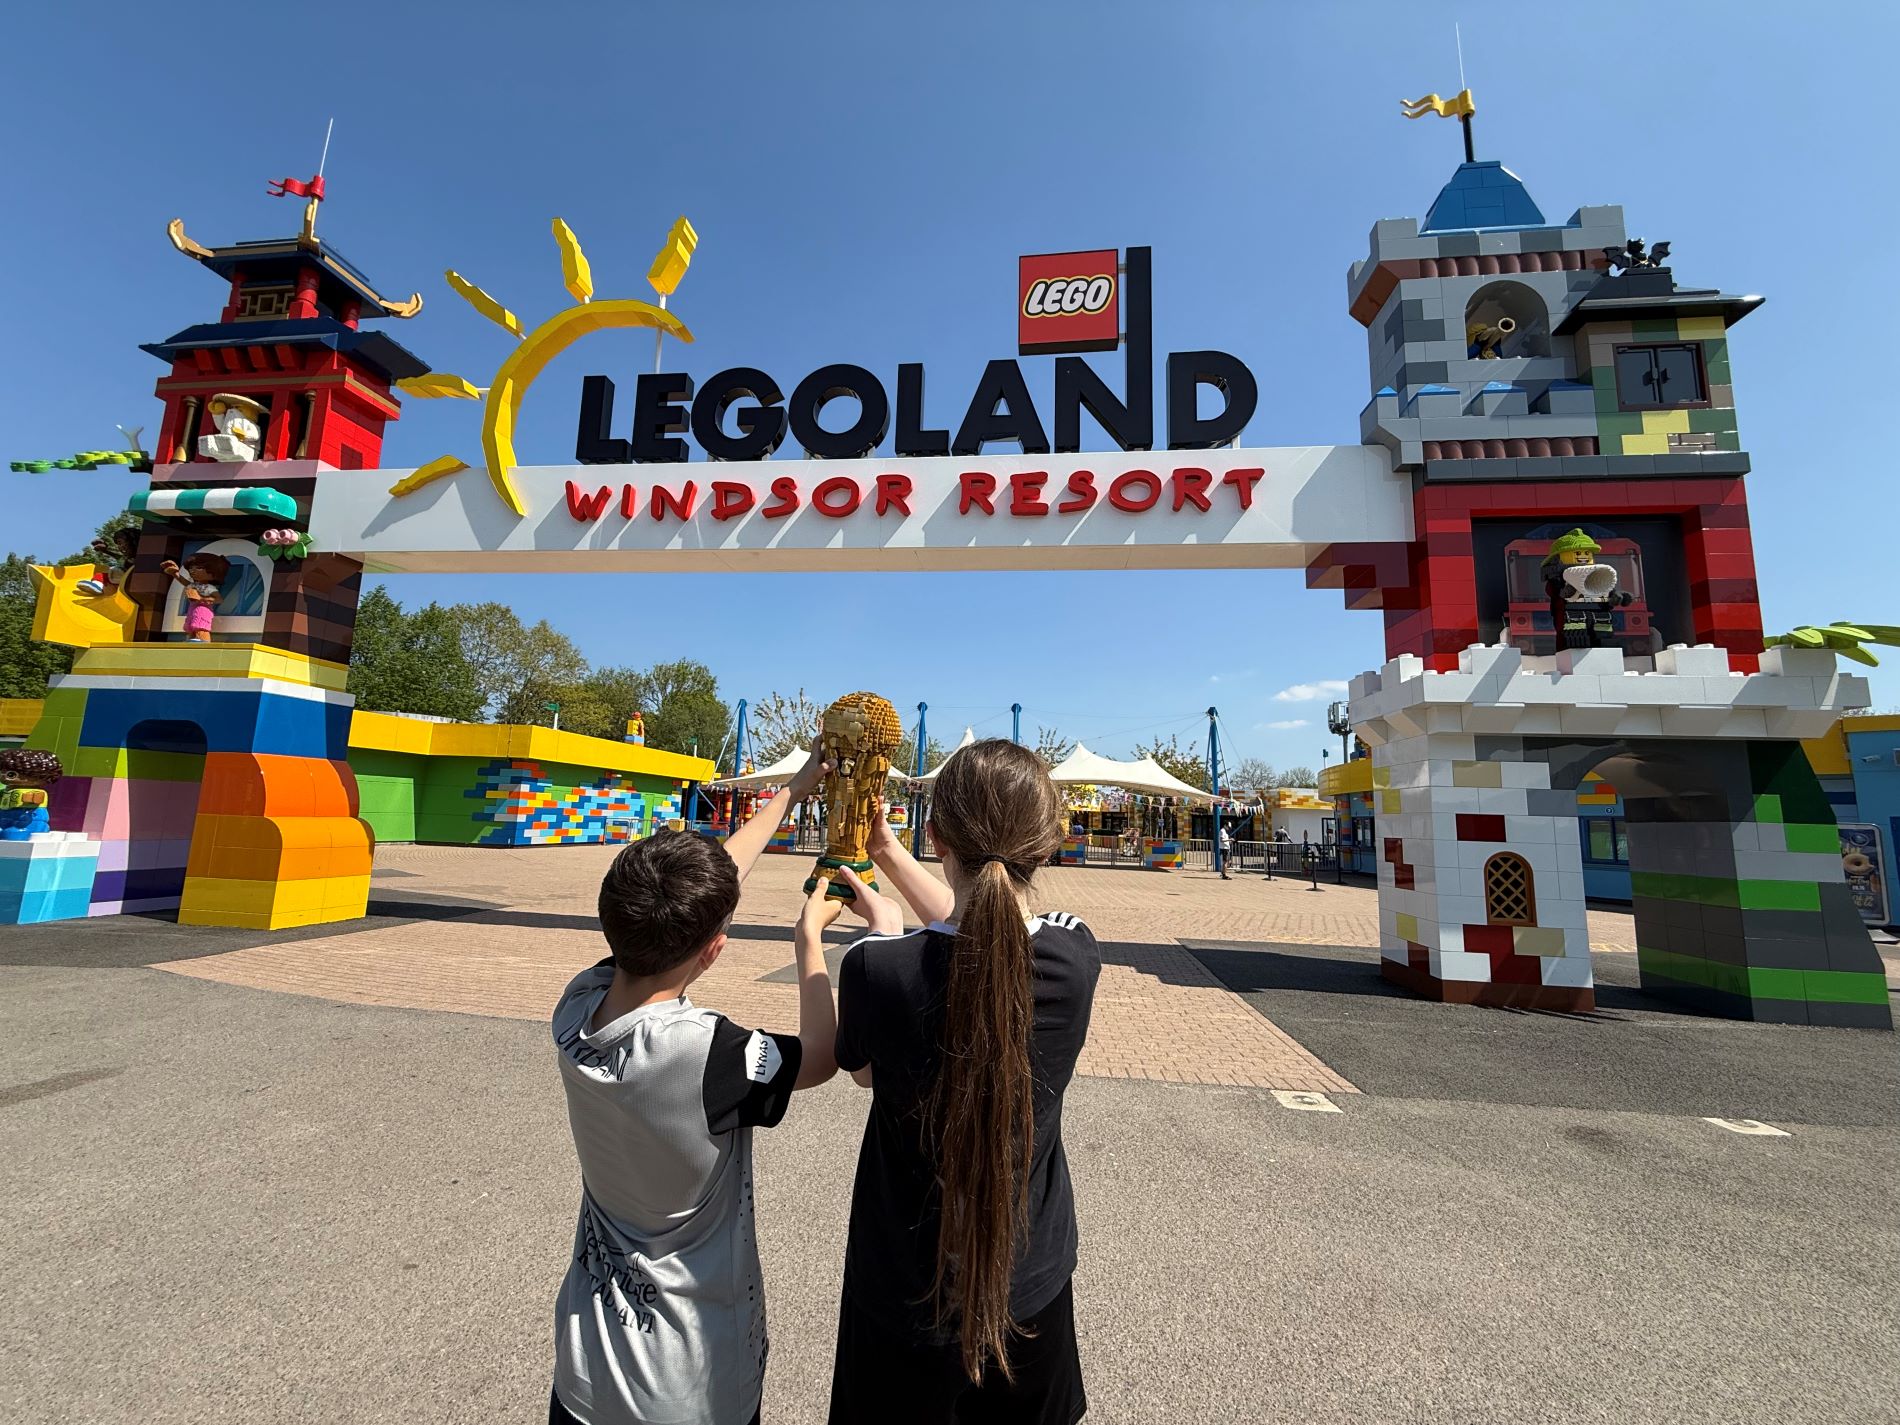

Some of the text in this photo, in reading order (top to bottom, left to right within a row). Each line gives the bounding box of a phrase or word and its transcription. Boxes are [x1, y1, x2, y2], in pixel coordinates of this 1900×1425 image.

[1026, 277, 1112, 315] LEGO
[576, 246, 1258, 464] LEGOLAND
[565, 468, 1265, 521] WINDSOR RESORT
[754, 1040, 768, 1076] LYNAS
